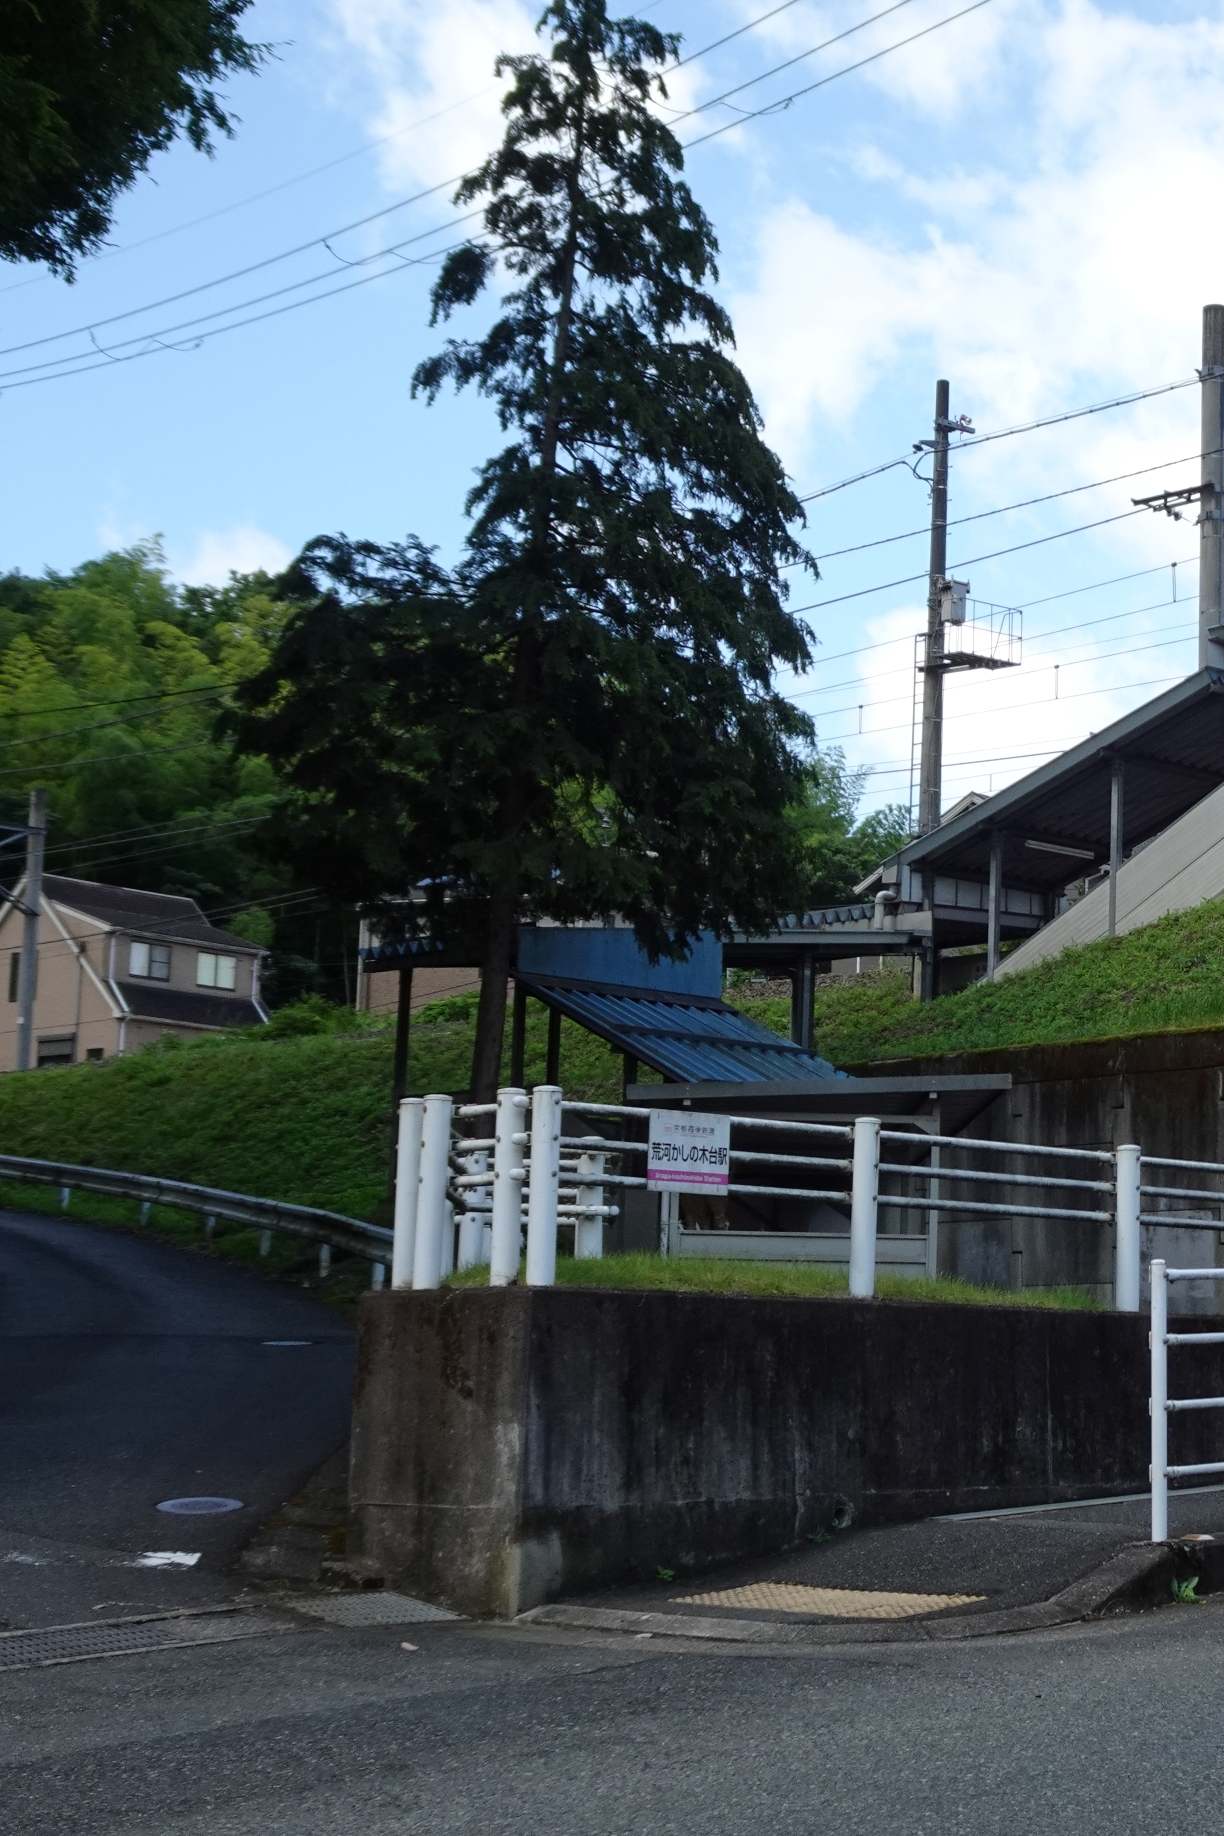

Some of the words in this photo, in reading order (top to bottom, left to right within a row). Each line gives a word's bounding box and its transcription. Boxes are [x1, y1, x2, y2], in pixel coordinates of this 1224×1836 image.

[651, 1142, 727, 1165] 荒河かしの木台駅
